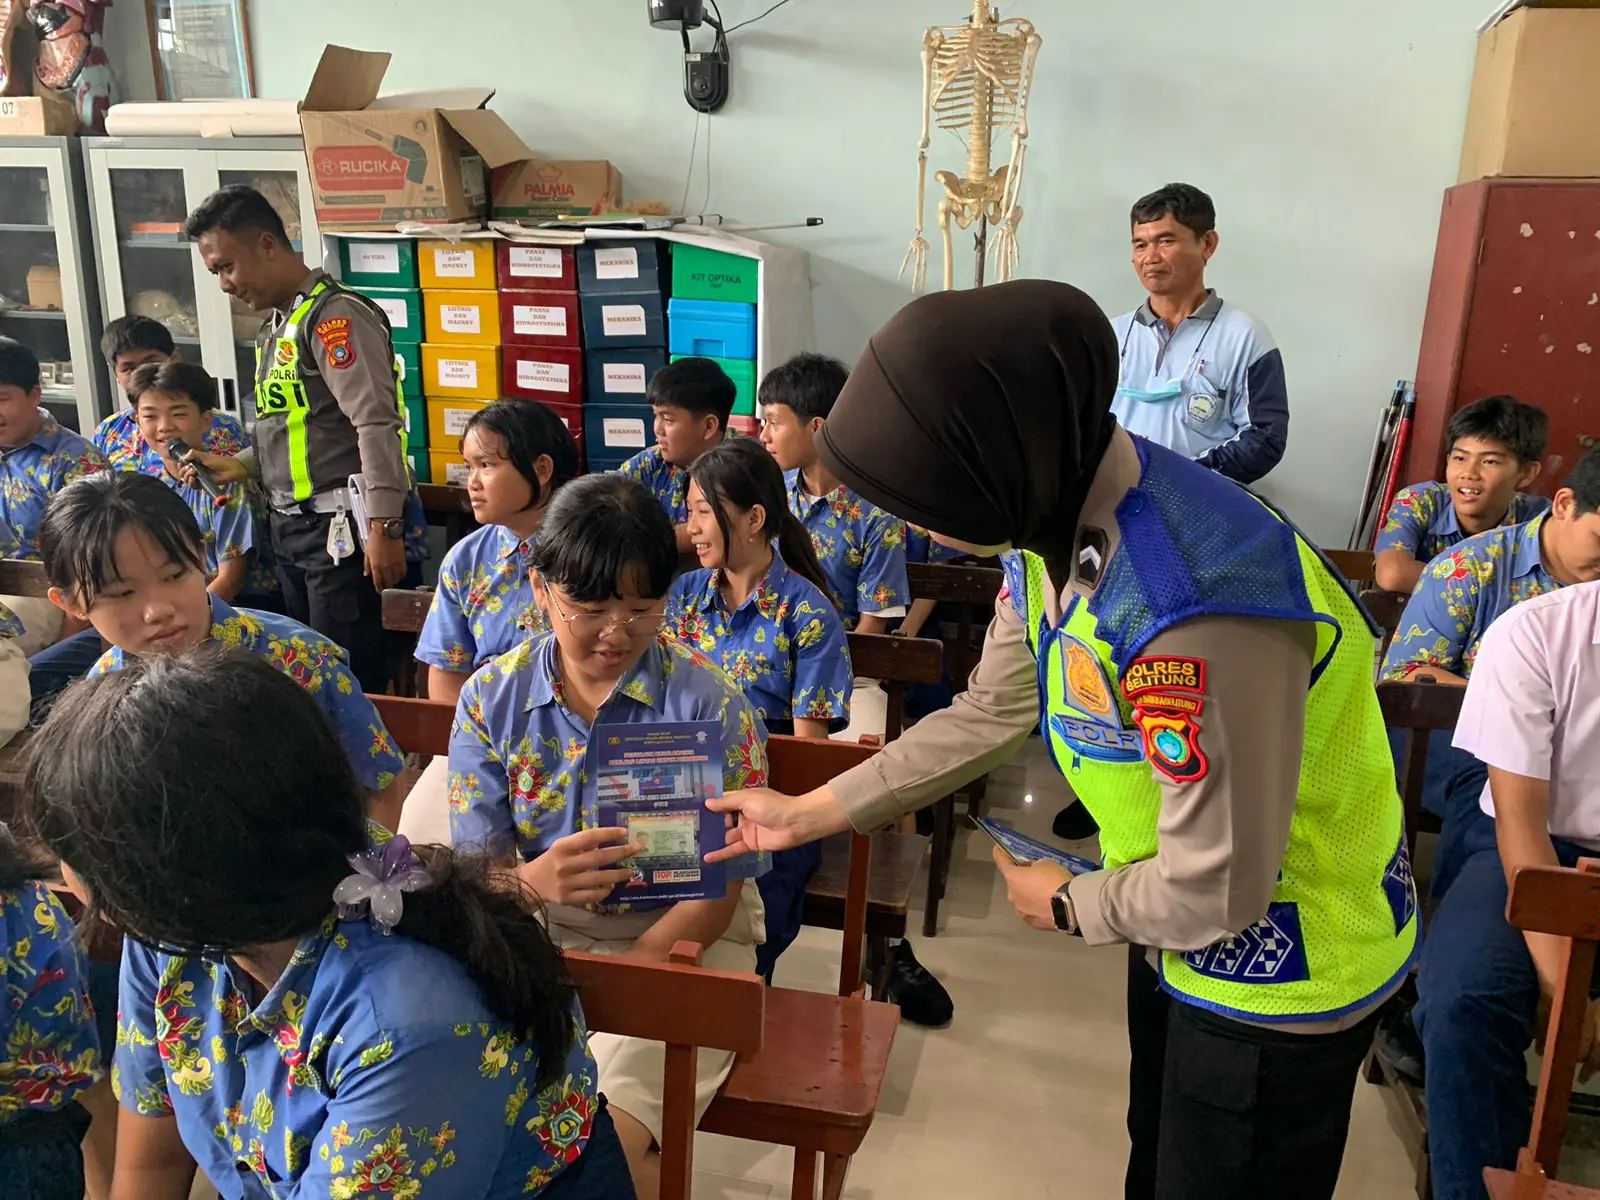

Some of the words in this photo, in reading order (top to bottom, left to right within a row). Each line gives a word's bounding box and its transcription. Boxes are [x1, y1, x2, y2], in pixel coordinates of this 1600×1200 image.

[340, 159, 402, 174] RUCIKA
[524, 184, 575, 196] PALMIA
[691, 272, 706, 282] KIT
[708, 273, 743, 285] OPTIKA
[269, 369, 296, 380] POLRI
[1126, 661, 1195, 682] POLRES
[1125, 674, 1197, 691] BELITUNG
